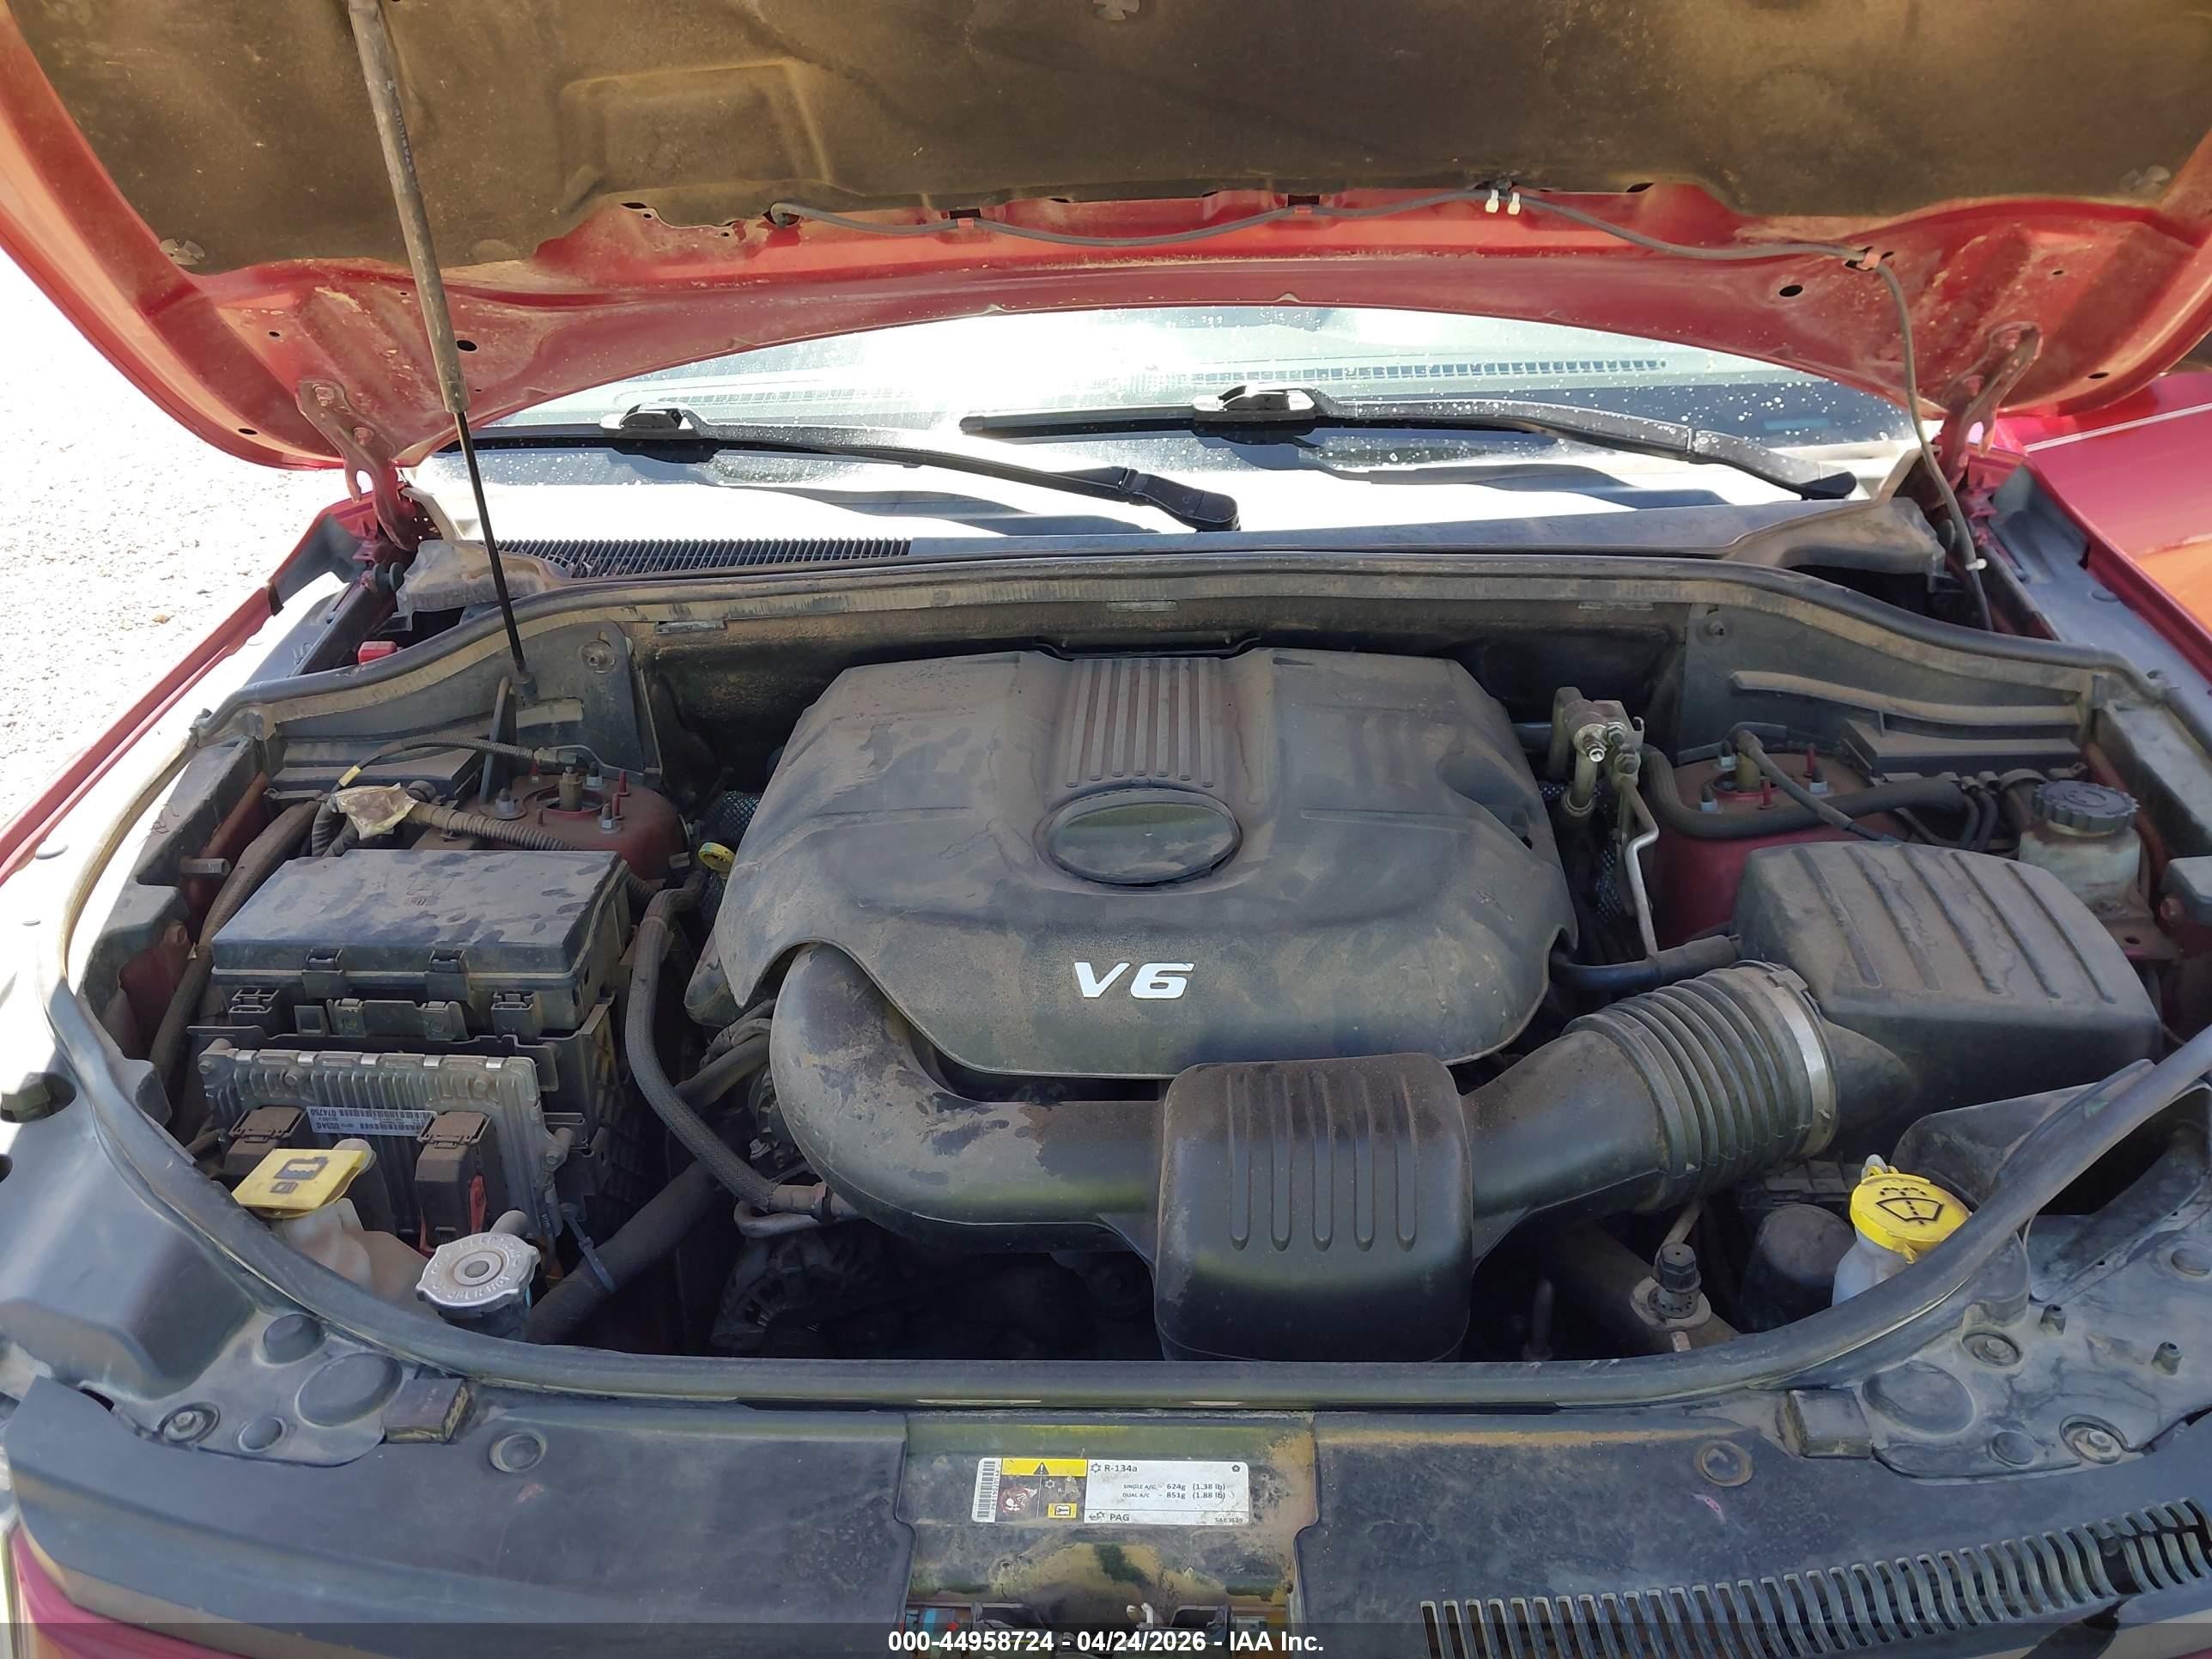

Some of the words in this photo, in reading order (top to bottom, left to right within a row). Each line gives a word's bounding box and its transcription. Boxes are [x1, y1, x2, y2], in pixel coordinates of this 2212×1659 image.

[1073, 962, 1195, 1000] V6
[1104, 1463, 1138, 1473] R-134a
[1166, 1483, 1187, 1492] 624g
[1193, 1483, 1213, 1492] (1.38
[1215, 1483, 1225, 1492] lb)
[1166, 1492, 1187, 1500] 851g
[1193, 1492, 1213, 1500] (1.88
[1215, 1492, 1225, 1501] lb)
[1109, 1513, 1130, 1522] PAG
